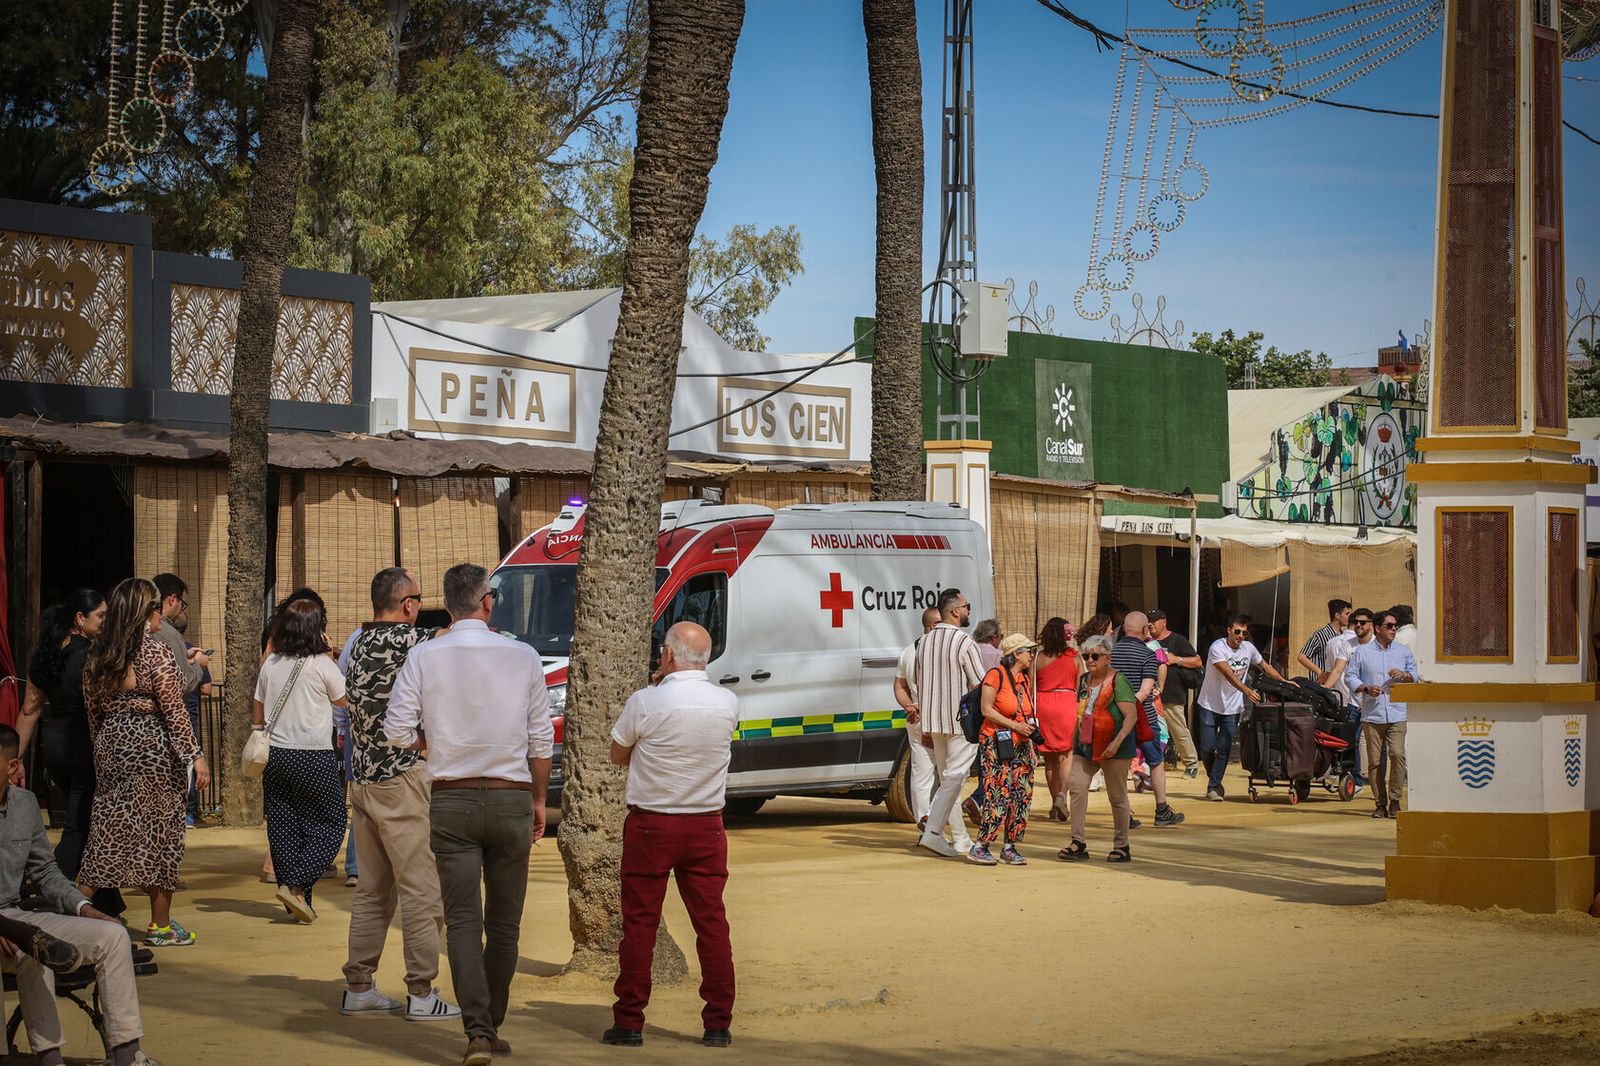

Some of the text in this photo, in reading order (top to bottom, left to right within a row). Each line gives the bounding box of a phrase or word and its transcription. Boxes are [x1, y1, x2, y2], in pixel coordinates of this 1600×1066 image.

[440, 368, 545, 422] PEÑA
[726, 398, 844, 443] LOS CIEN
[811, 534, 895, 549] AMBULANCIA
[1141, 522, 1154, 533] LOS
[862, 582, 942, 611] Cruz Roj
